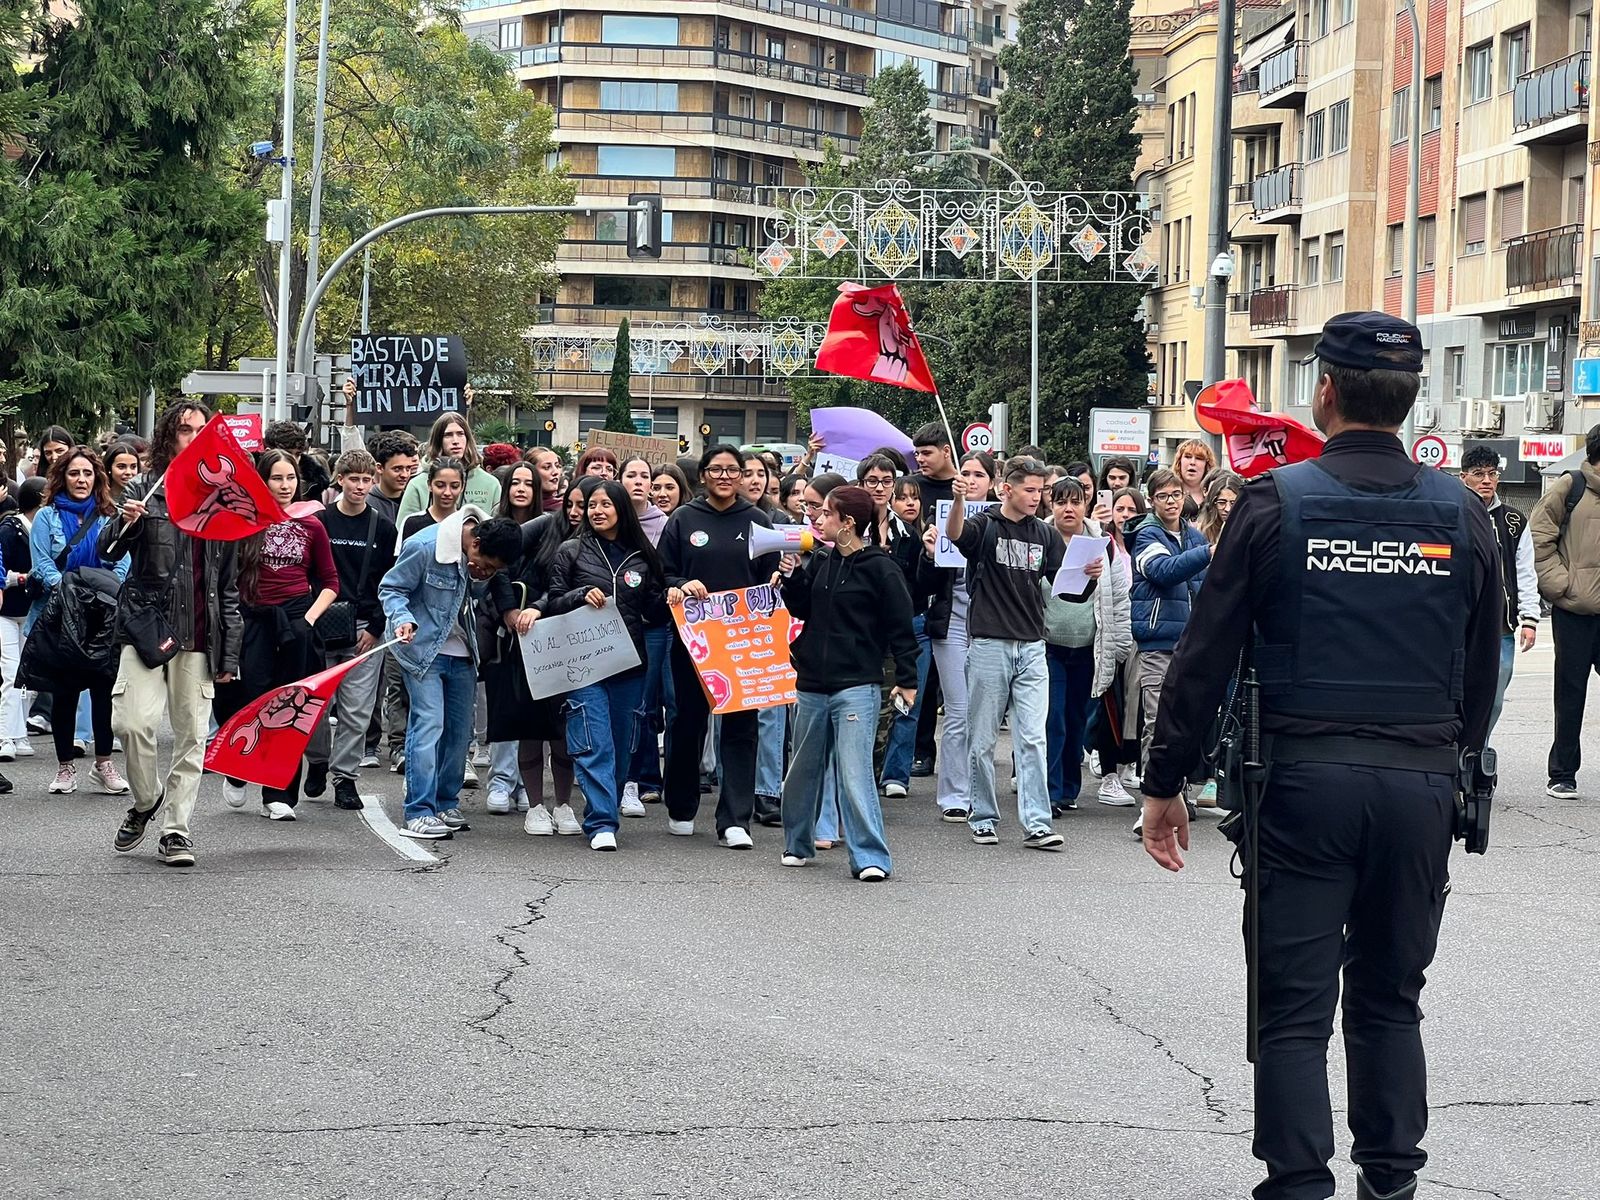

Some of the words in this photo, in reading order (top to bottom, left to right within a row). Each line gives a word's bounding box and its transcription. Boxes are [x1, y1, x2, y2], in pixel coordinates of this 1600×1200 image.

[351, 336, 418, 361] BASTA
[421, 337, 449, 362] DE
[351, 363, 423, 388] MIRAR
[428, 362, 442, 386] A
[356, 388, 392, 413] UN
[402, 387, 458, 412] LADO
[615, 434, 666, 451] BULLYING
[970, 434, 989, 446] 30
[1420, 446, 1440, 459] 30
[1307, 538, 1424, 558] POLICIA
[1306, 555, 1451, 576] NACIONAL
[531, 639, 543, 654] NO
[547, 636, 561, 650] AL
